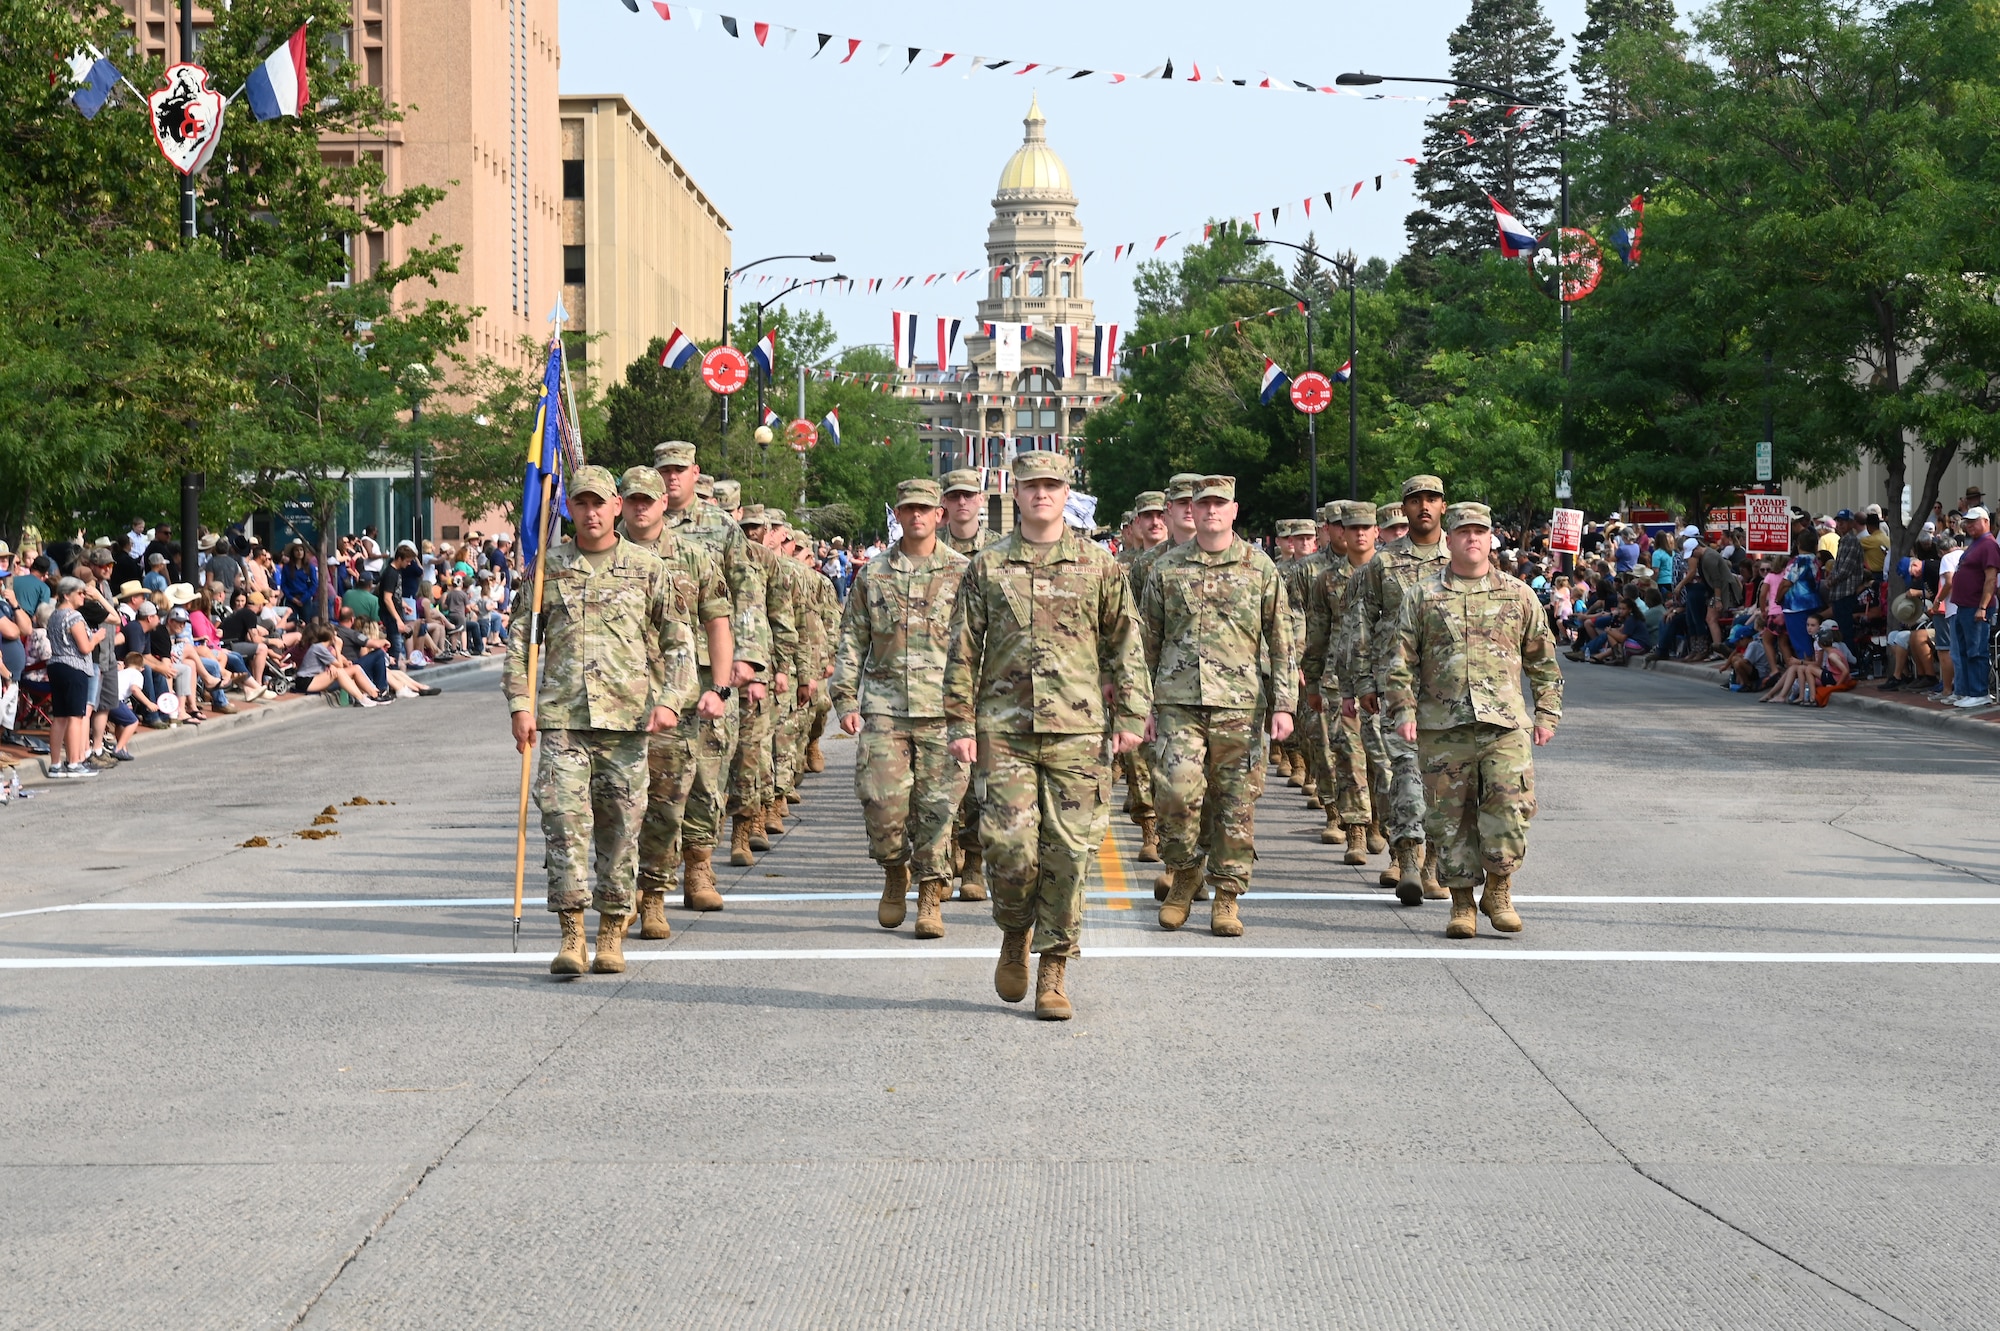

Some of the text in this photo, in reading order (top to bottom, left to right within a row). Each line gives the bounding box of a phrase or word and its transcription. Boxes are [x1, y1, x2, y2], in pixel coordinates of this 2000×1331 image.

[1753, 506, 1785, 514] ROUTE
[1750, 514, 1787, 523] NO PARKING
[1083, 567, 1101, 575] FORCE
